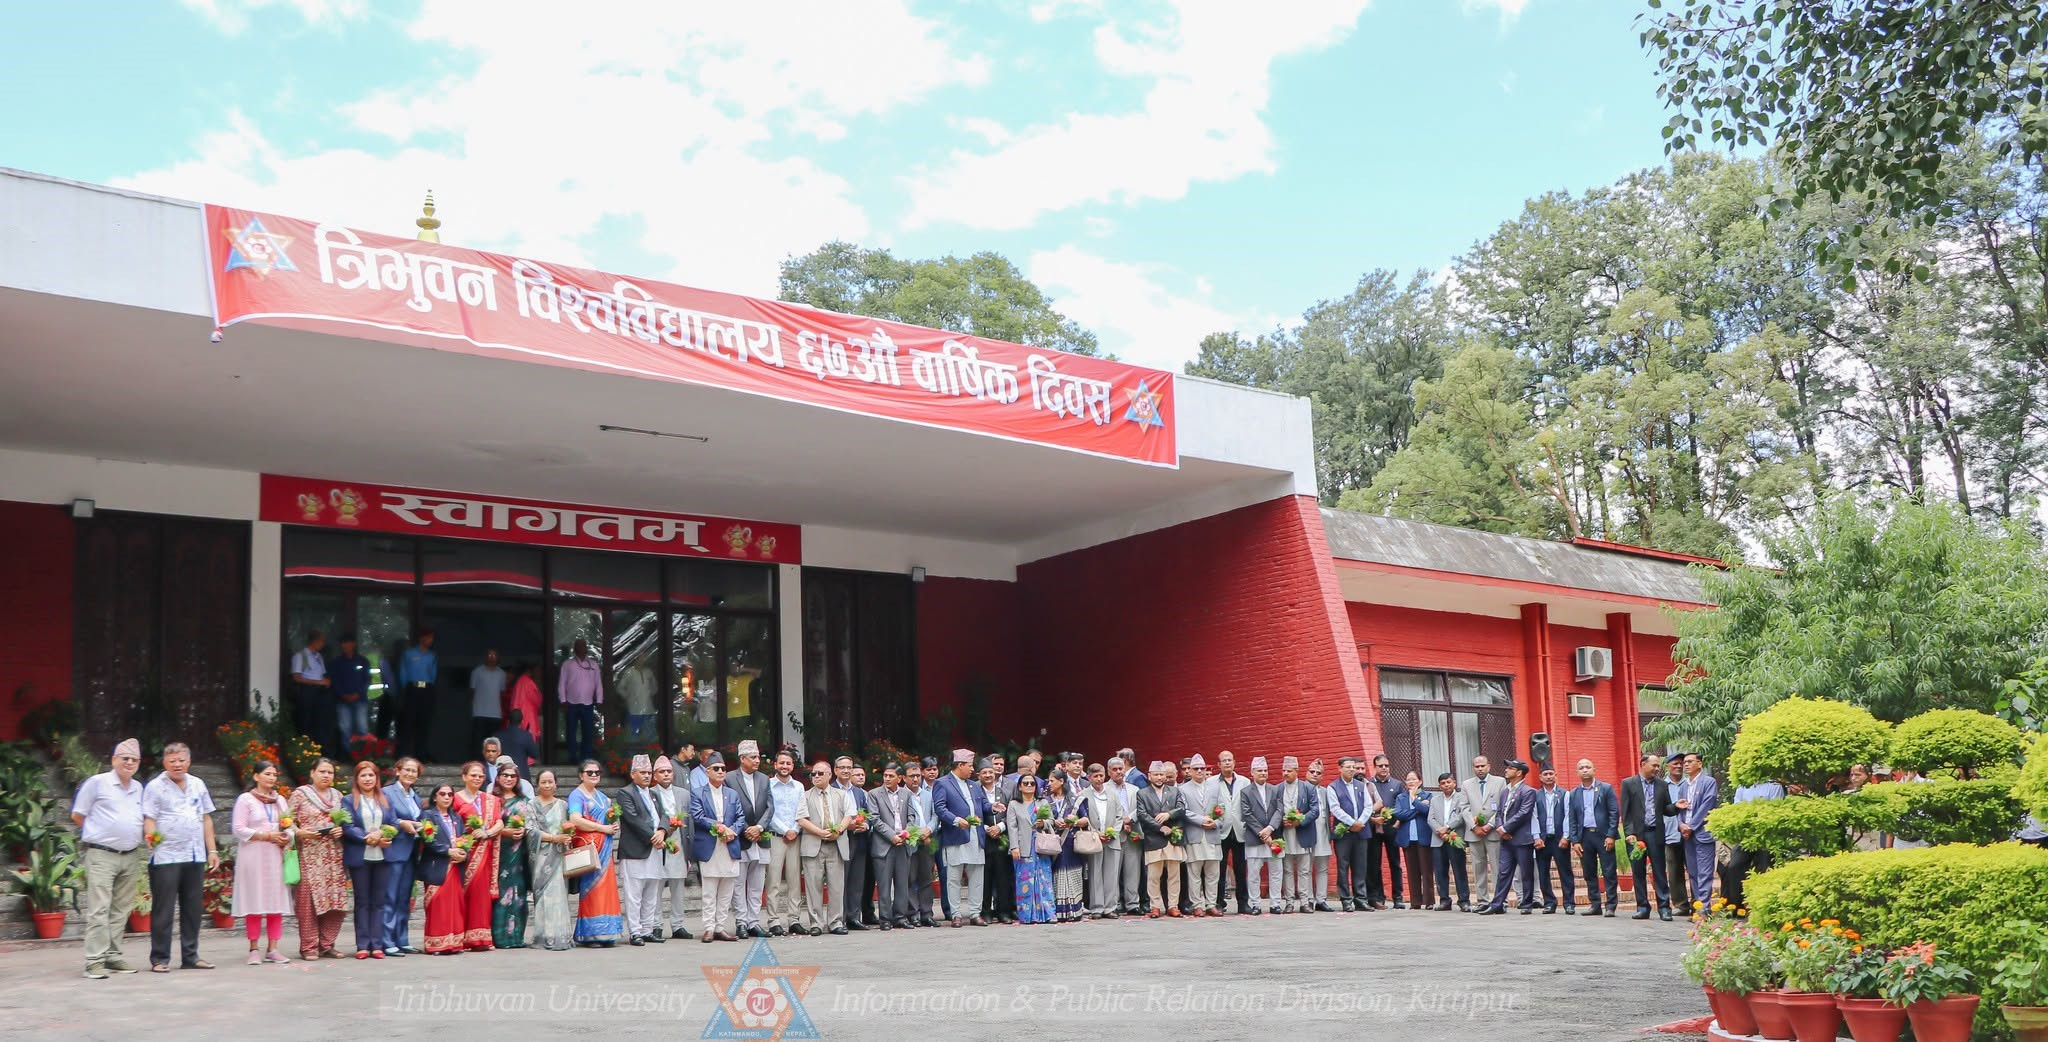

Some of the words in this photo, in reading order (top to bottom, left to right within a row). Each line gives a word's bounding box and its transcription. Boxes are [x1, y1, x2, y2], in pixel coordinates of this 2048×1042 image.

[314, 222, 498, 312] त्रिभुवन
[512, 259, 785, 368] विश्वविद्यालय
[909, 339, 1019, 404] वार्षिक
[1027, 354, 1112, 425] दिवस
[380, 491, 710, 553] स्वागतम्
